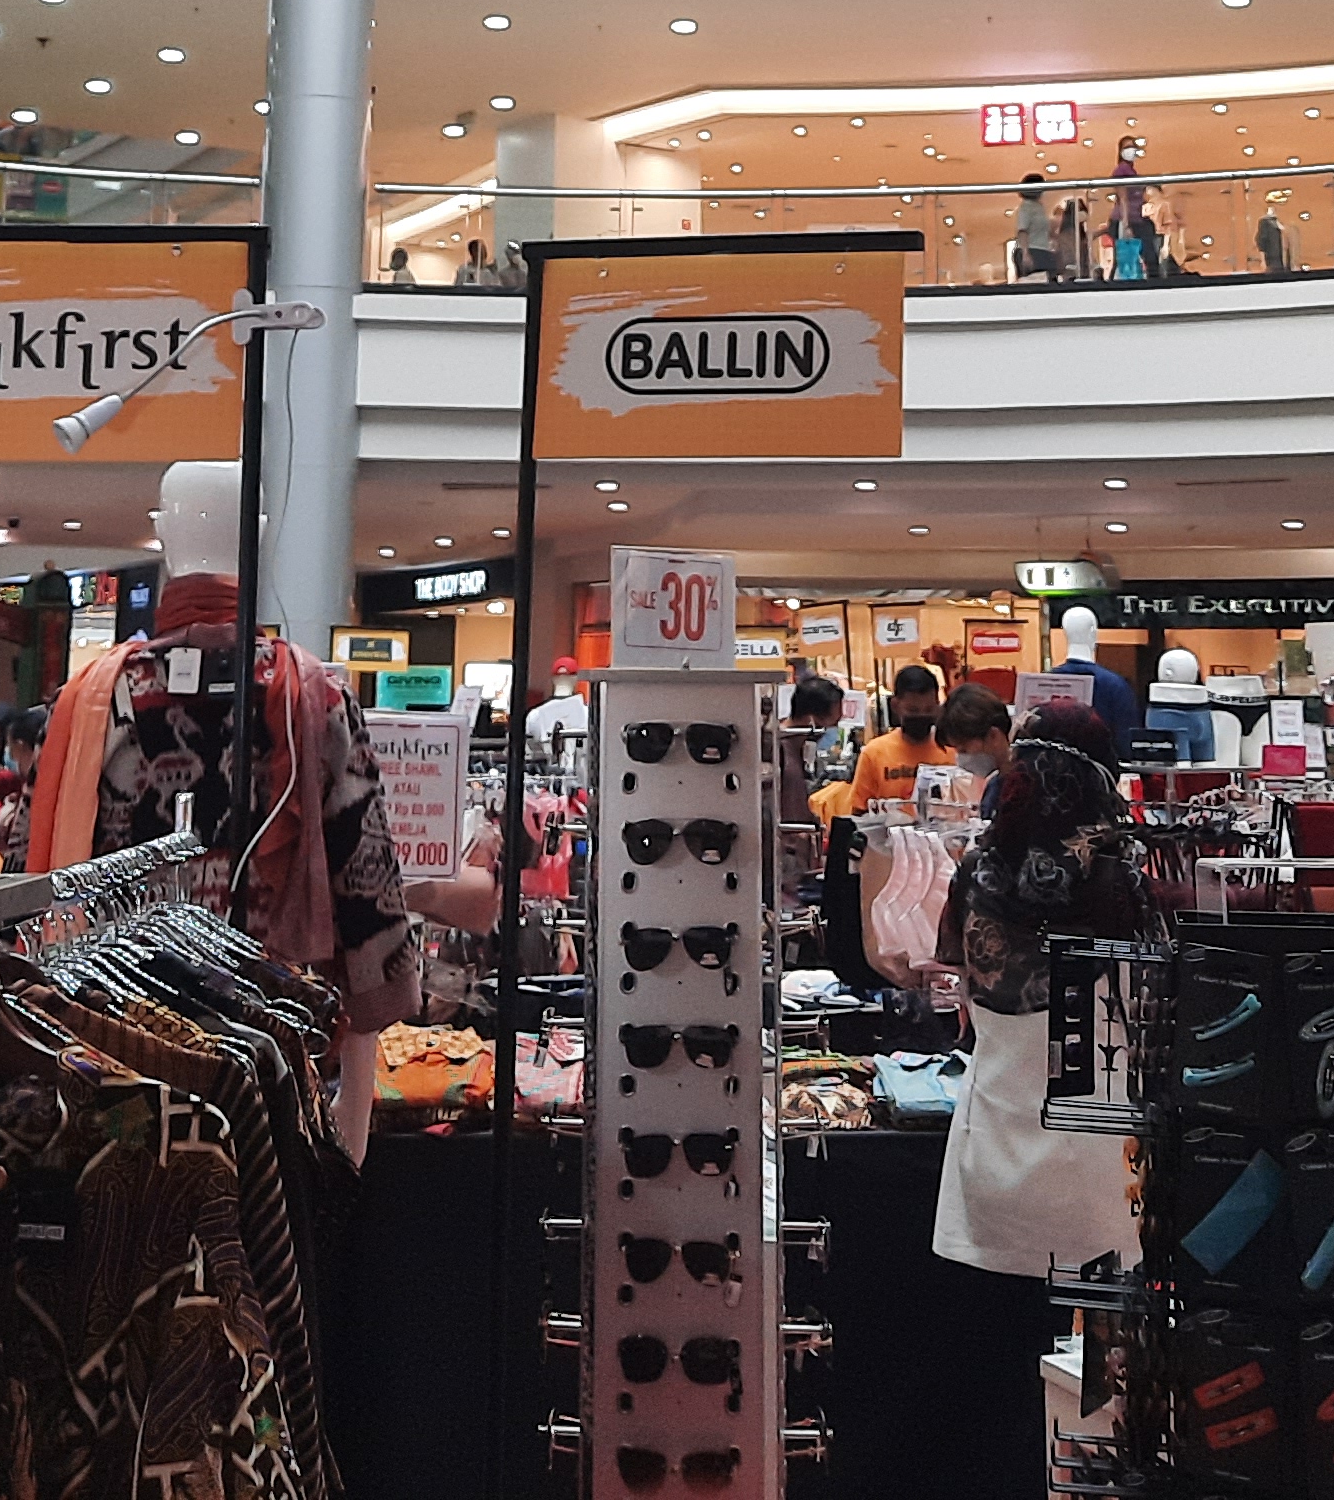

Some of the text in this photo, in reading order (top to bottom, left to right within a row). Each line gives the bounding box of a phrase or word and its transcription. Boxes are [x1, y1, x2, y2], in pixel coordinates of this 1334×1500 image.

[621, 330, 814, 380] BALLIN
[630, 570, 720, 642] SALE 30%
[393, 781, 421, 796] ATAU
[390, 821, 427, 836] EMEJA
